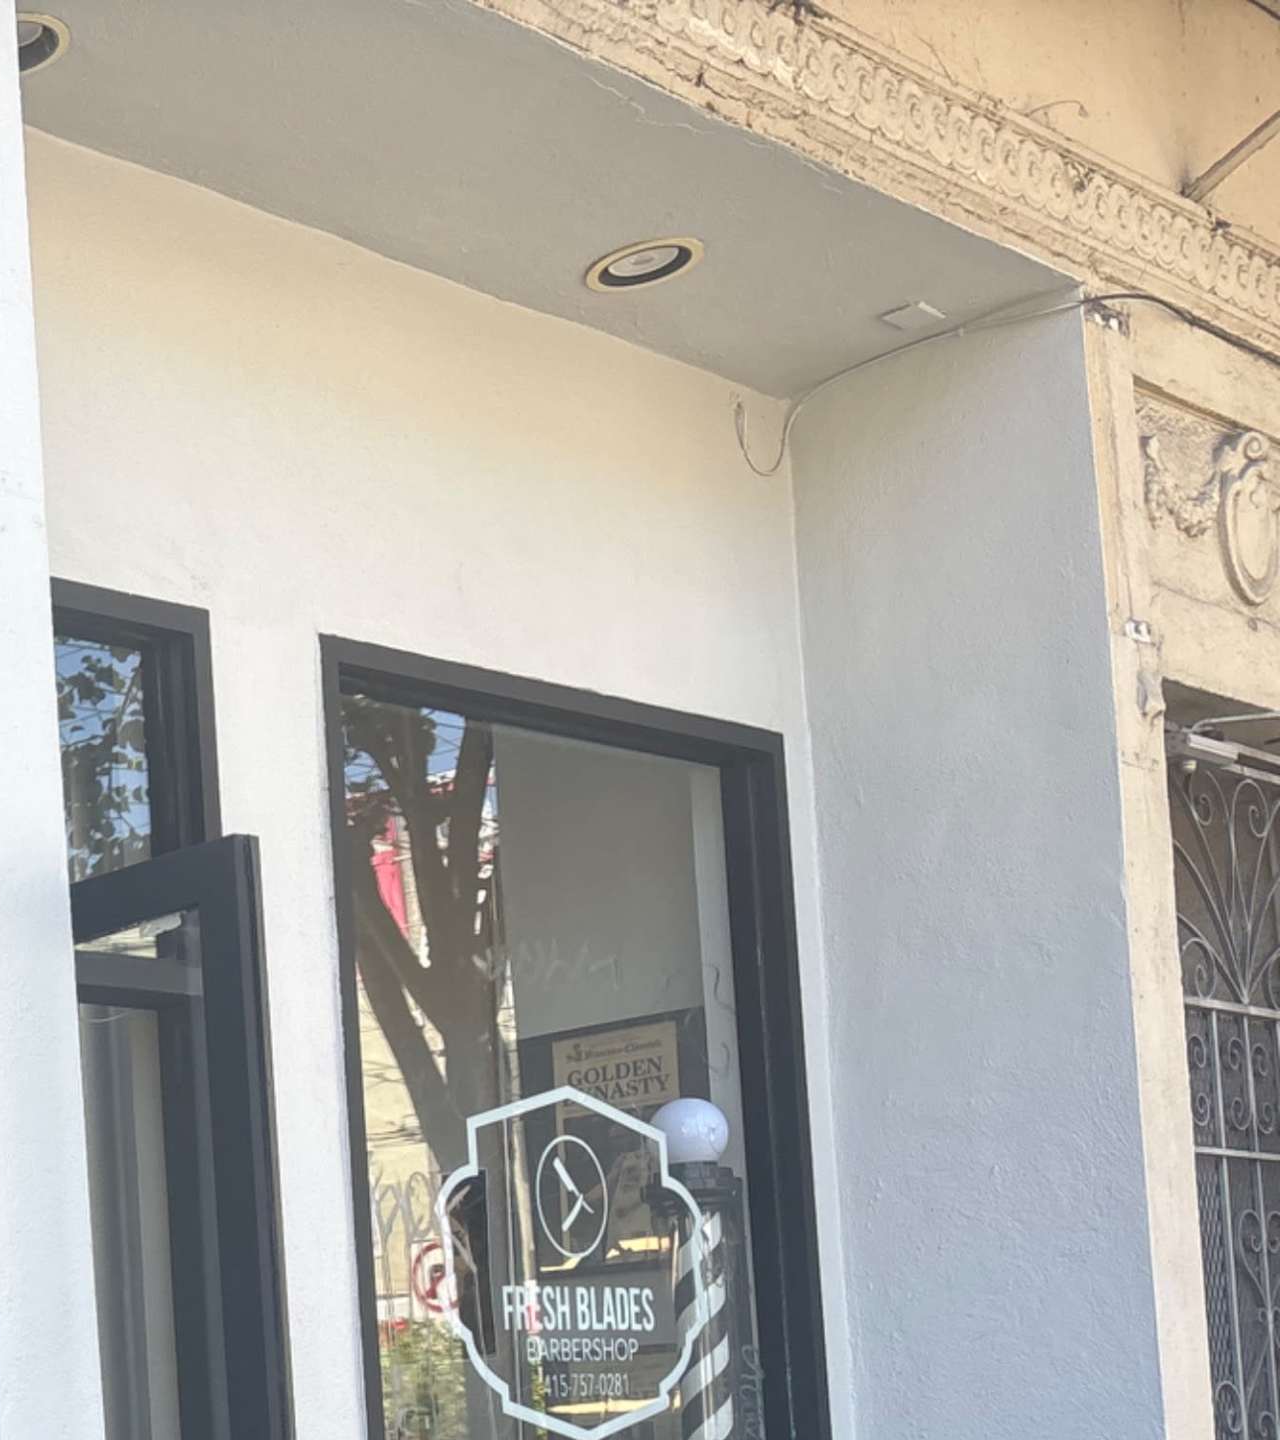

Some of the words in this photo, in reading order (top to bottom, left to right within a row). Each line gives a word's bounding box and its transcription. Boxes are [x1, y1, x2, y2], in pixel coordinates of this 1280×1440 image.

[567, 1056, 663, 1087] GOLDEN
[502, 1285, 572, 1331] FRESH
[576, 1286, 655, 1332] BLADES
[526, 1337, 639, 1362] BARBERSHOP
[543, 1373, 631, 1398] 415-757-0281
